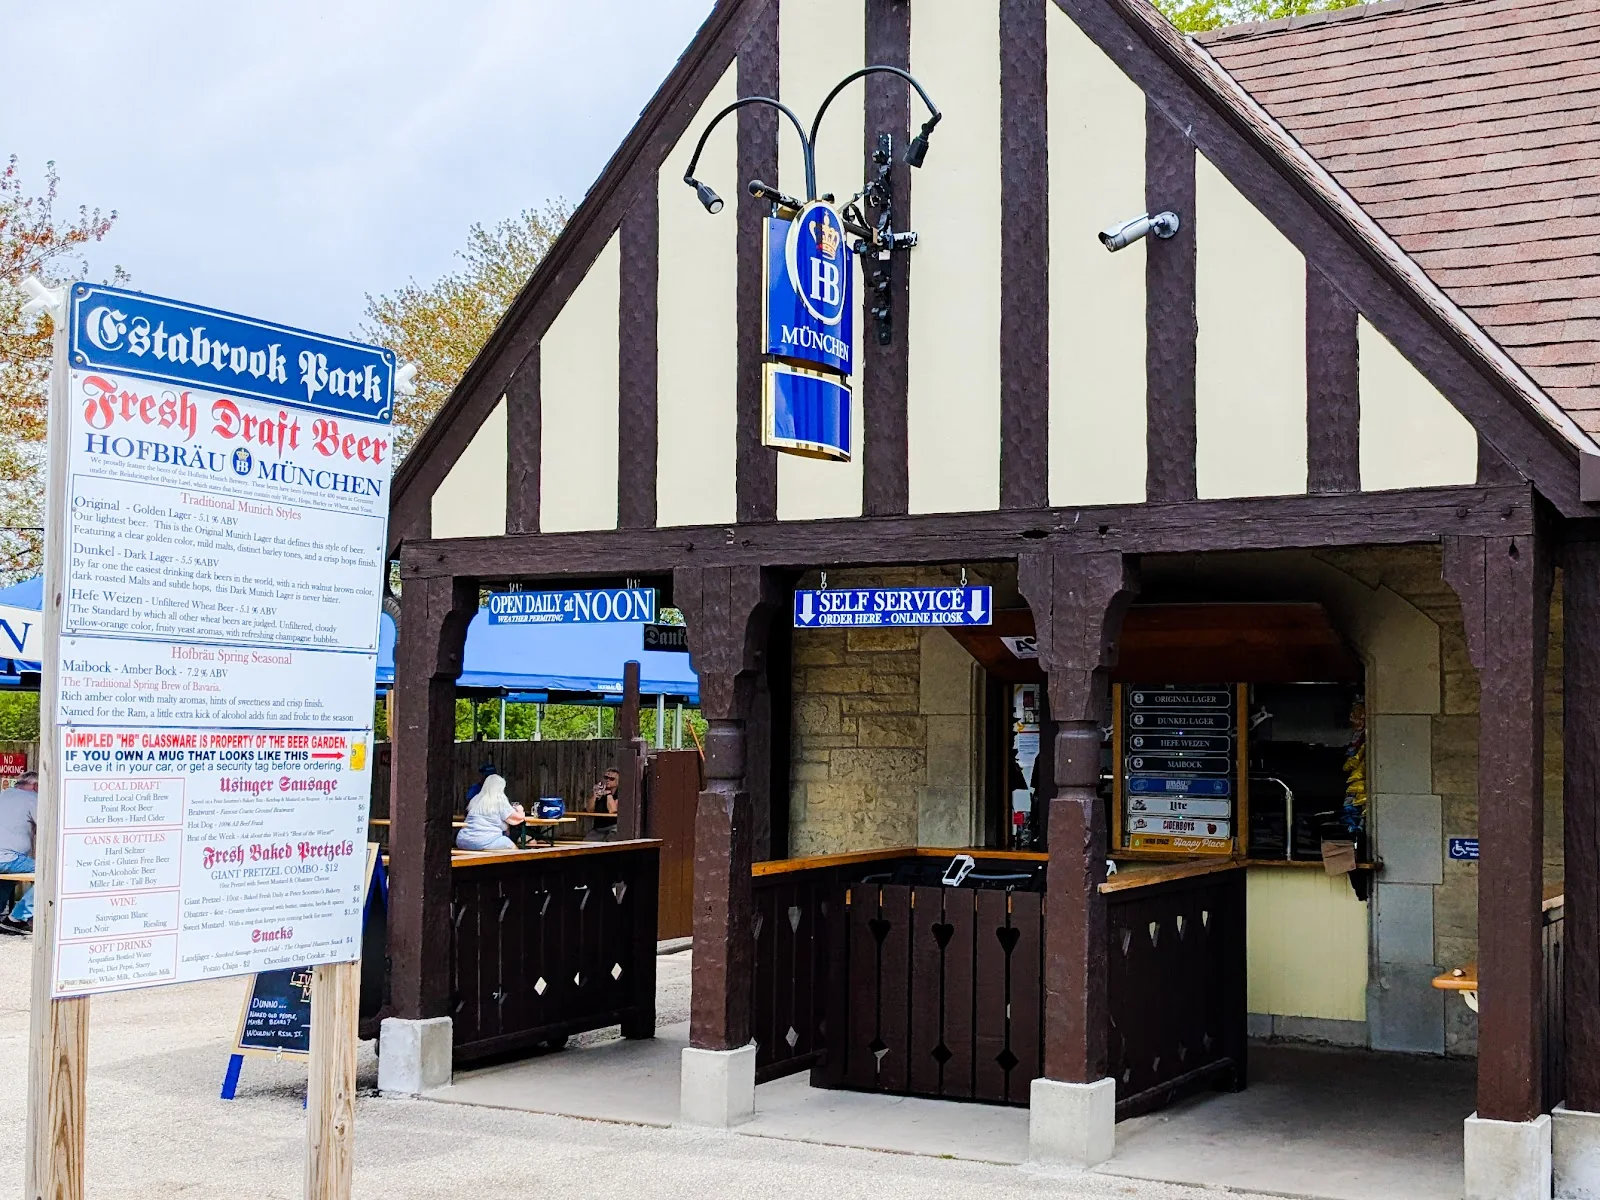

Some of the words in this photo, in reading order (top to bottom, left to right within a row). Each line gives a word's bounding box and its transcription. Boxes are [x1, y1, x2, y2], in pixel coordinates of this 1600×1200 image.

[810, 257, 840, 305] HB
[781, 325, 849, 362] MÜNCHEN
[86, 306, 288, 384] Estabrook
[299, 351, 382, 403] Park
[83, 376, 197, 442] Fresh
[212, 399, 301, 459] Draft
[312, 418, 388, 465] Beer
[85, 432, 226, 473] HOFBRÄU
[258, 460, 382, 496] MÜNCHEN
[74, 495, 119, 511] Original
[132, 503, 165, 516] Golden
[168, 507, 191, 520] Lager
[198, 513, 208, 522] 5.1
[211, 515, 218, 523] %
[220, 516, 238, 525] ABV
[180, 491, 234, 510] Traditional
[238, 500, 273, 516] Munich
[275, 506, 301, 520] Styles
[73, 542, 114, 556] Dunkel
[124, 548, 146, 559] Dark
[149, 551, 173, 563] Lager
[180, 555, 192, 564] 5.5
[194, 558, 219, 567] %ABV
[72, 588, 99, 600] Hefe
[103, 590, 142, 604] Weizen
[151, 596, 189, 608] Unfiltered
[191, 600, 215, 610] Wheat
[217, 602, 234, 612] Beer
[240, 605, 250, 613] 5.1
[260, 607, 277, 616] ABV
[490, 594, 522, 614] OPEN
[524, 593, 563, 613] DAILY
[564, 597, 574, 612] at
[573, 590, 652, 621] NOON
[819, 591, 870, 612] SELF
[874, 590, 965, 611] SERVICE
[498, 614, 528, 622] WEATHER
[819, 614, 852, 625] ORDER
[855, 614, 882, 624] HERE
[891, 613, 930, 624] ONLINE
[932, 612, 964, 623] KIOSK
[172, 646, 214, 660] Hofbräu
[217, 648, 249, 665] Spring
[251, 650, 292, 664] Seasonal
[63, 659, 111, 672] Maibock
[121, 663, 151, 674] Amber
[155, 664, 176, 675] Bock
[187, 667, 199, 676] 7.2
[200, 669, 207, 677] %
[209, 668, 228, 677] ABV
[61, 676, 80, 686] The
[82, 677, 131, 688] Traditional
[133, 679, 159, 691] Spring
[161, 680, 181, 690] Brew
[182, 681, 191, 690] of
[192, 681, 220, 691] Bavaria.
[66, 733, 113, 747] DIMPLED
[117, 733, 139, 747] "HB"
[142, 734, 196, 748] GLASSWARE
[199, 734, 207, 748] IS
[210, 734, 253, 748] PROPERTY
[256, 735, 266, 748] OF
[268, 735, 285, 748] THE
[287, 735, 308, 748] BEER
[311, 735, 347, 748] GARDEN.
[4, 755, 14, 764] NO
[66, 750, 76, 760] IF
[83, 750, 110, 760] YOU
[115, 750, 143, 761] OWN
[147, 750, 154, 760] A
[158, 750, 184, 760] MUG
[188, 750, 216, 760] THAT
[219, 750, 254, 760] LOOKS
[257, 750, 280, 760] LIKE
[284, 751, 308, 760] THIS
[65, 761, 102, 772] Leave
[106, 761, 112, 771] it
[116, 761, 125, 771] in
[129, 763, 152, 774] your
[155, 763, 173, 772] car,
[176, 763, 187, 771] or
[189, 762, 204, 773] get
[207, 763, 213, 771] a
[216, 761, 252, 772] security
[254, 761, 268, 772] tag
[271, 760, 300, 770] before
[303, 760, 343, 772] ordering.
[93, 781, 128, 791] LOCAL
[130, 781, 161, 790] DRAFT
[220, 776, 273, 796] Usinger
[279, 776, 337, 795] Sausage
[83, 793, 114, 802] Featured
[115, 793, 133, 801] Local
[135, 793, 151, 801] Craft
[100, 804, 118, 812] Point
[137, 803, 153, 811] Beer
[85, 815, 105, 823] Cider
[107, 815, 123, 824] Boys
[129, 814, 146, 822] Hard
[147, 813, 165, 821] Cider
[1163, 820, 1195, 831] CIDERBOYS
[83, 835, 111, 845] CANS
[112, 834, 120, 844] &
[122, 832, 165, 843] BOTTLES
[1173, 838, 1201, 850] Happy
[1202, 838, 1225, 848] Place
[203, 844, 244, 869] Fresh
[249, 842, 292, 861] Baked
[297, 839, 353, 863] Pretzels
[210, 869, 241, 880] GIANT
[243, 866, 282, 877] PRETZEL
[284, 863, 318, 874] COMBO
[324, 862, 338, 872] $12
[109, 896, 137, 906] WINE
[95, 912, 129, 922] Sauvignon
[130, 911, 148, 919] Blanc
[143, 919, 167, 928] Riesling
[73, 926, 92, 934] Pinot
[94, 924, 109, 932] Noir
[251, 926, 293, 943] Snacks
[88, 942, 114, 954] SOFT
[116, 938, 152, 951] DRINKS
[291, 972, 312, 984] LIV
